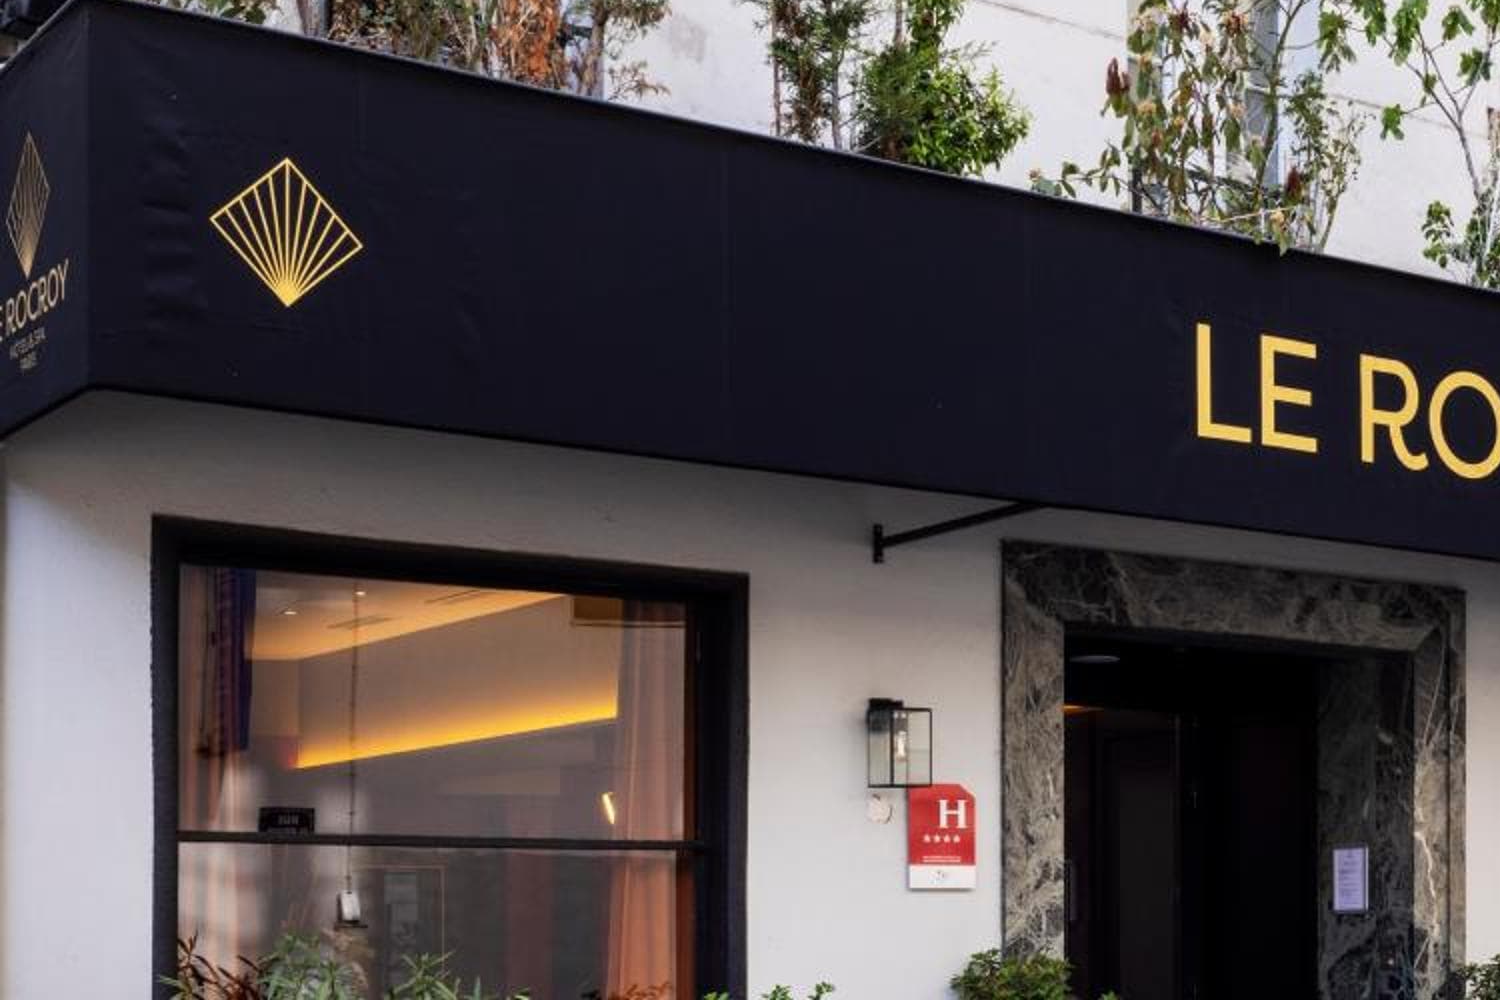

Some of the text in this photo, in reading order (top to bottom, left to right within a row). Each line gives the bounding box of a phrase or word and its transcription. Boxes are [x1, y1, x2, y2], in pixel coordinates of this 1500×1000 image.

[6, 258, 70, 337] ROCROY
[1195, 321, 1319, 453] LE
[936, 799, 969, 829] H
